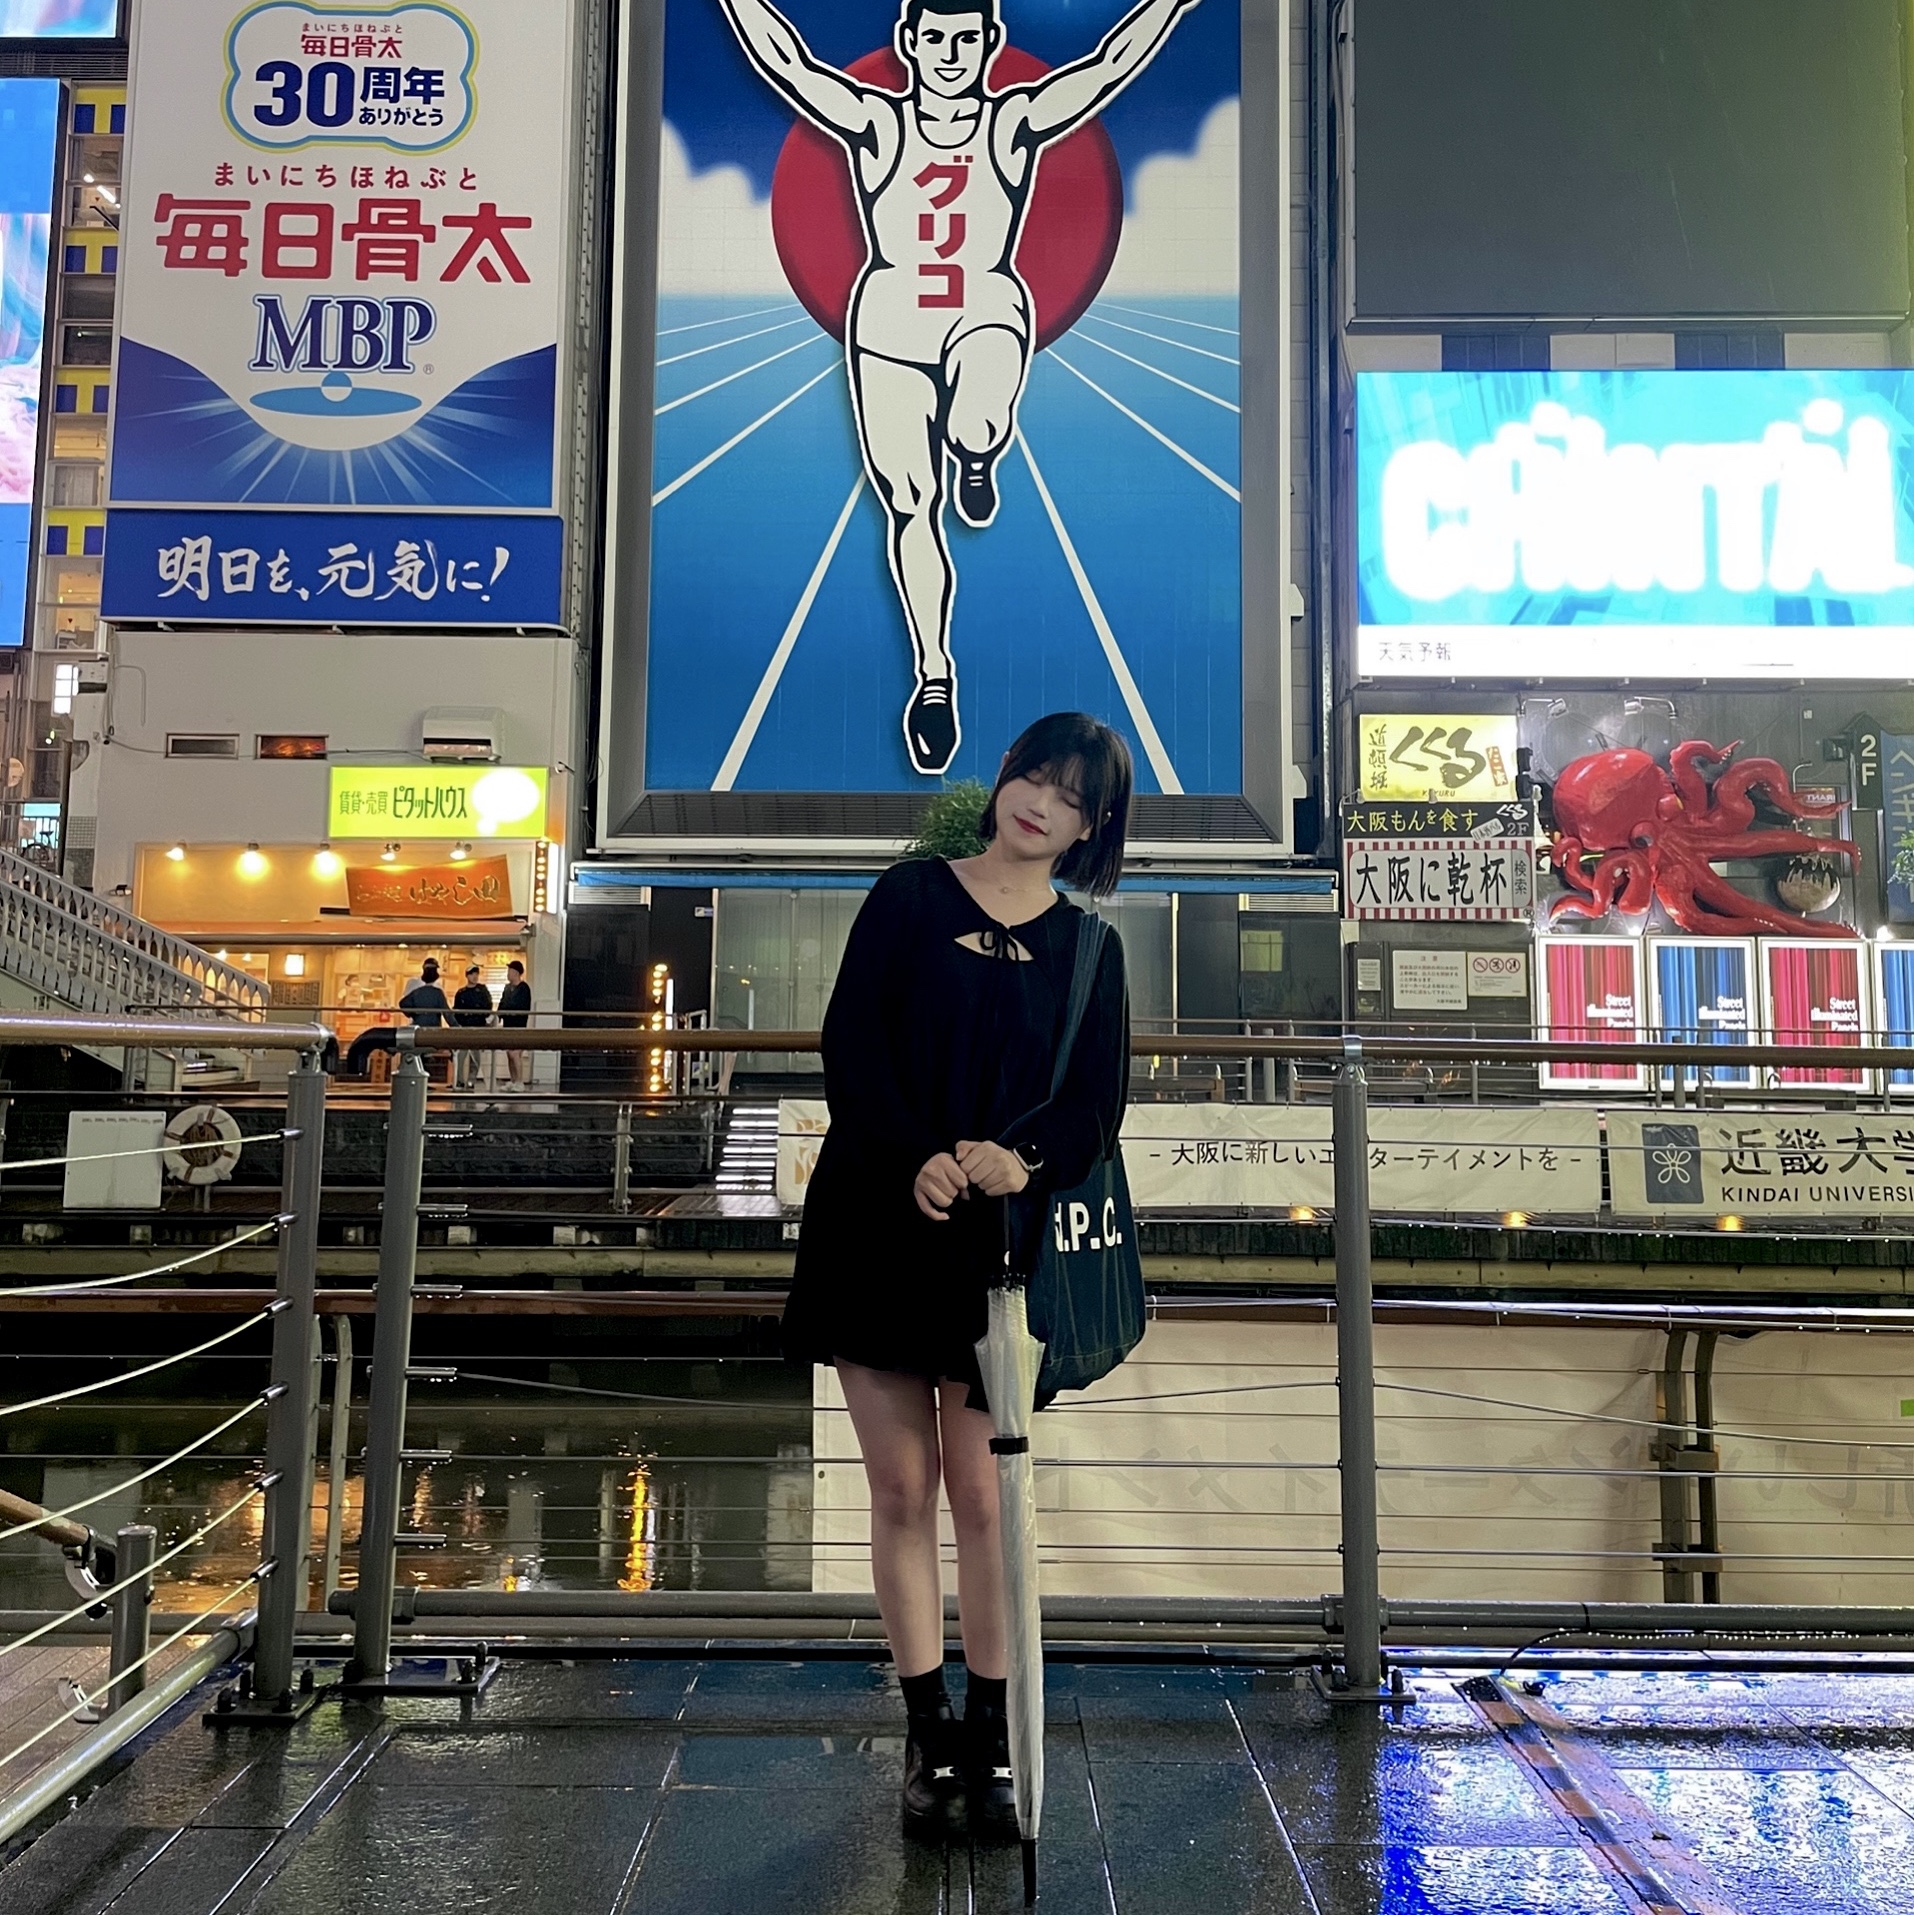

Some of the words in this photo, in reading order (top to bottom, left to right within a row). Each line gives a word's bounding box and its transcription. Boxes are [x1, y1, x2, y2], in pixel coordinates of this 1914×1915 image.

[301, 22, 403, 34] まいにちほねぶと
[300, 34, 404, 59] 毎日骨太
[254, 61, 445, 127] 30周年
[358, 107, 444, 127] ありがとう
[213, 162, 479, 191] まいにちほねぶと
[154, 193, 532, 283] 毎日骨太
[913, 155, 974, 310] グリコ
[248, 294, 437, 374] MBP
[1378, 641, 1452, 662] 天気予報
[1368, 724, 1388, 790] 道頓堀
[1389, 726, 1487, 789] くくる
[1860, 734, 1877, 786] 2F
[393, 786, 468, 819] ピタットハウス
[1347, 808, 1478, 833] 大阪もんを食す
[1507, 822, 1529, 836] 2F
[1356, 852, 1507, 906] 大阪に乾杯
[1514, 861, 1527, 894] 検索
[1170, 1140, 1559, 1171] 大阪に新しいエターテイメントを
[1721, 1186, 1799, 1202] KINDAI
